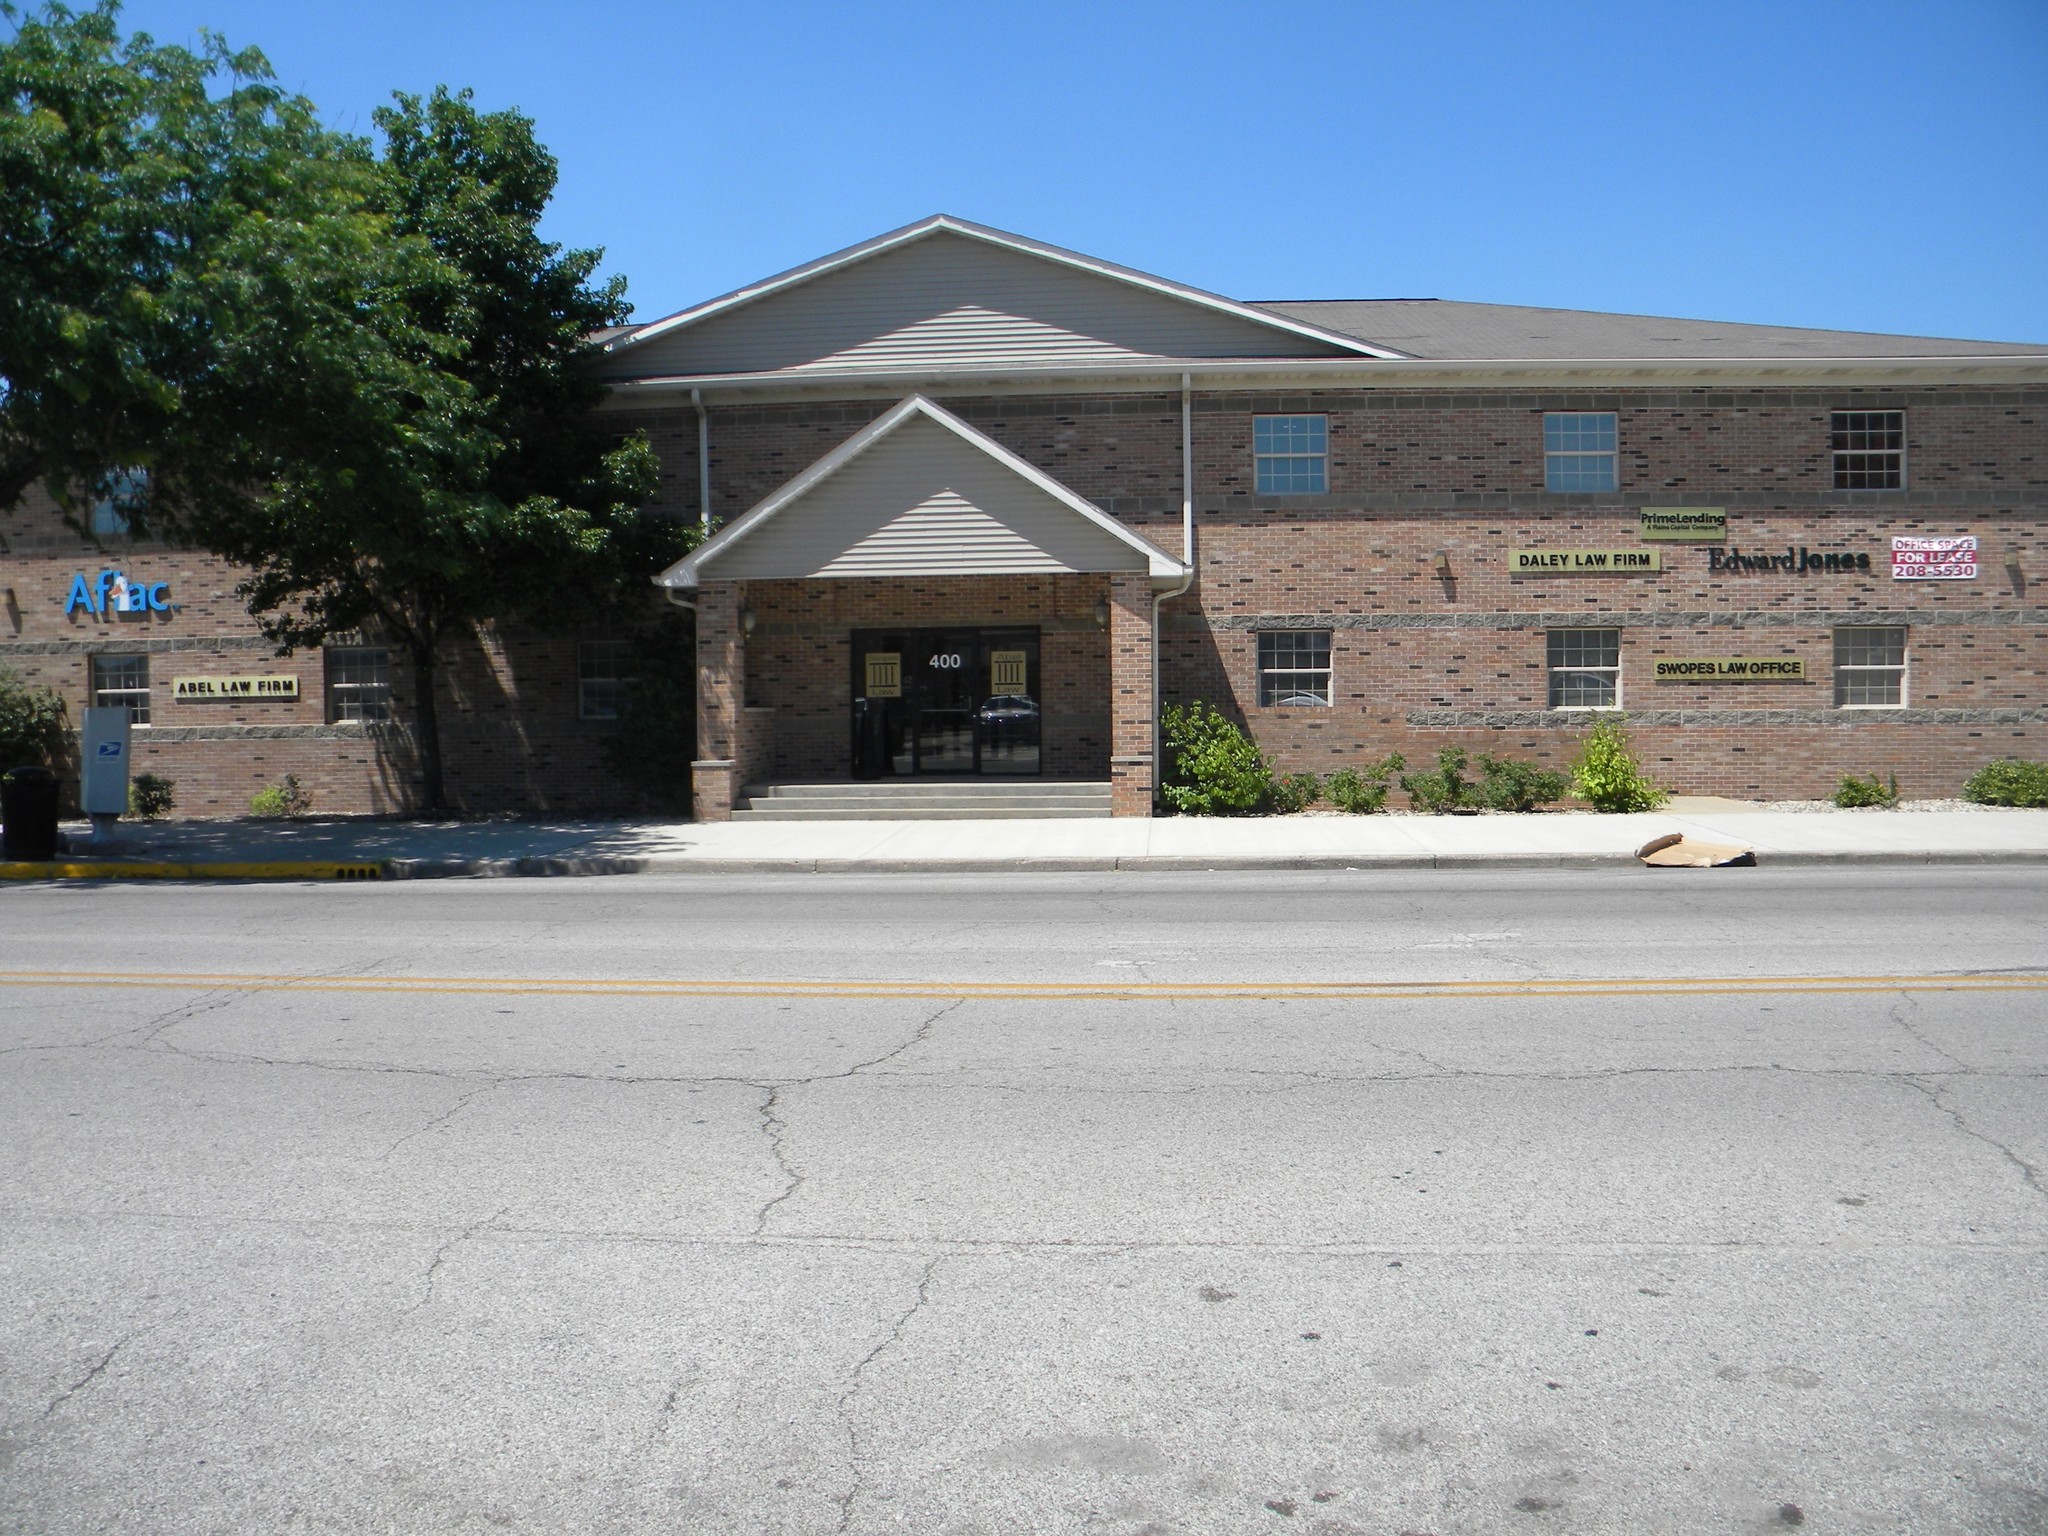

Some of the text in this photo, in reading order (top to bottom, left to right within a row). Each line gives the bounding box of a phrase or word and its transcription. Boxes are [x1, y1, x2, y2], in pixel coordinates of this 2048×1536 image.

[1641, 513, 1726, 526] PrimeLending
[1895, 540, 1973, 549] OFFICE SPACE
[1519, 554, 1651, 566] DALEY LAW FIRM
[1896, 551, 1973, 563] FOR LEASE
[1895, 565, 1974, 577] 208-5530
[64, 570, 170, 614] Aflac
[929, 654, 961, 669] 400
[1656, 662, 1801, 674] SWOPES LAW OFFICE
[178, 680, 293, 693] ABEL LAW FIRM
